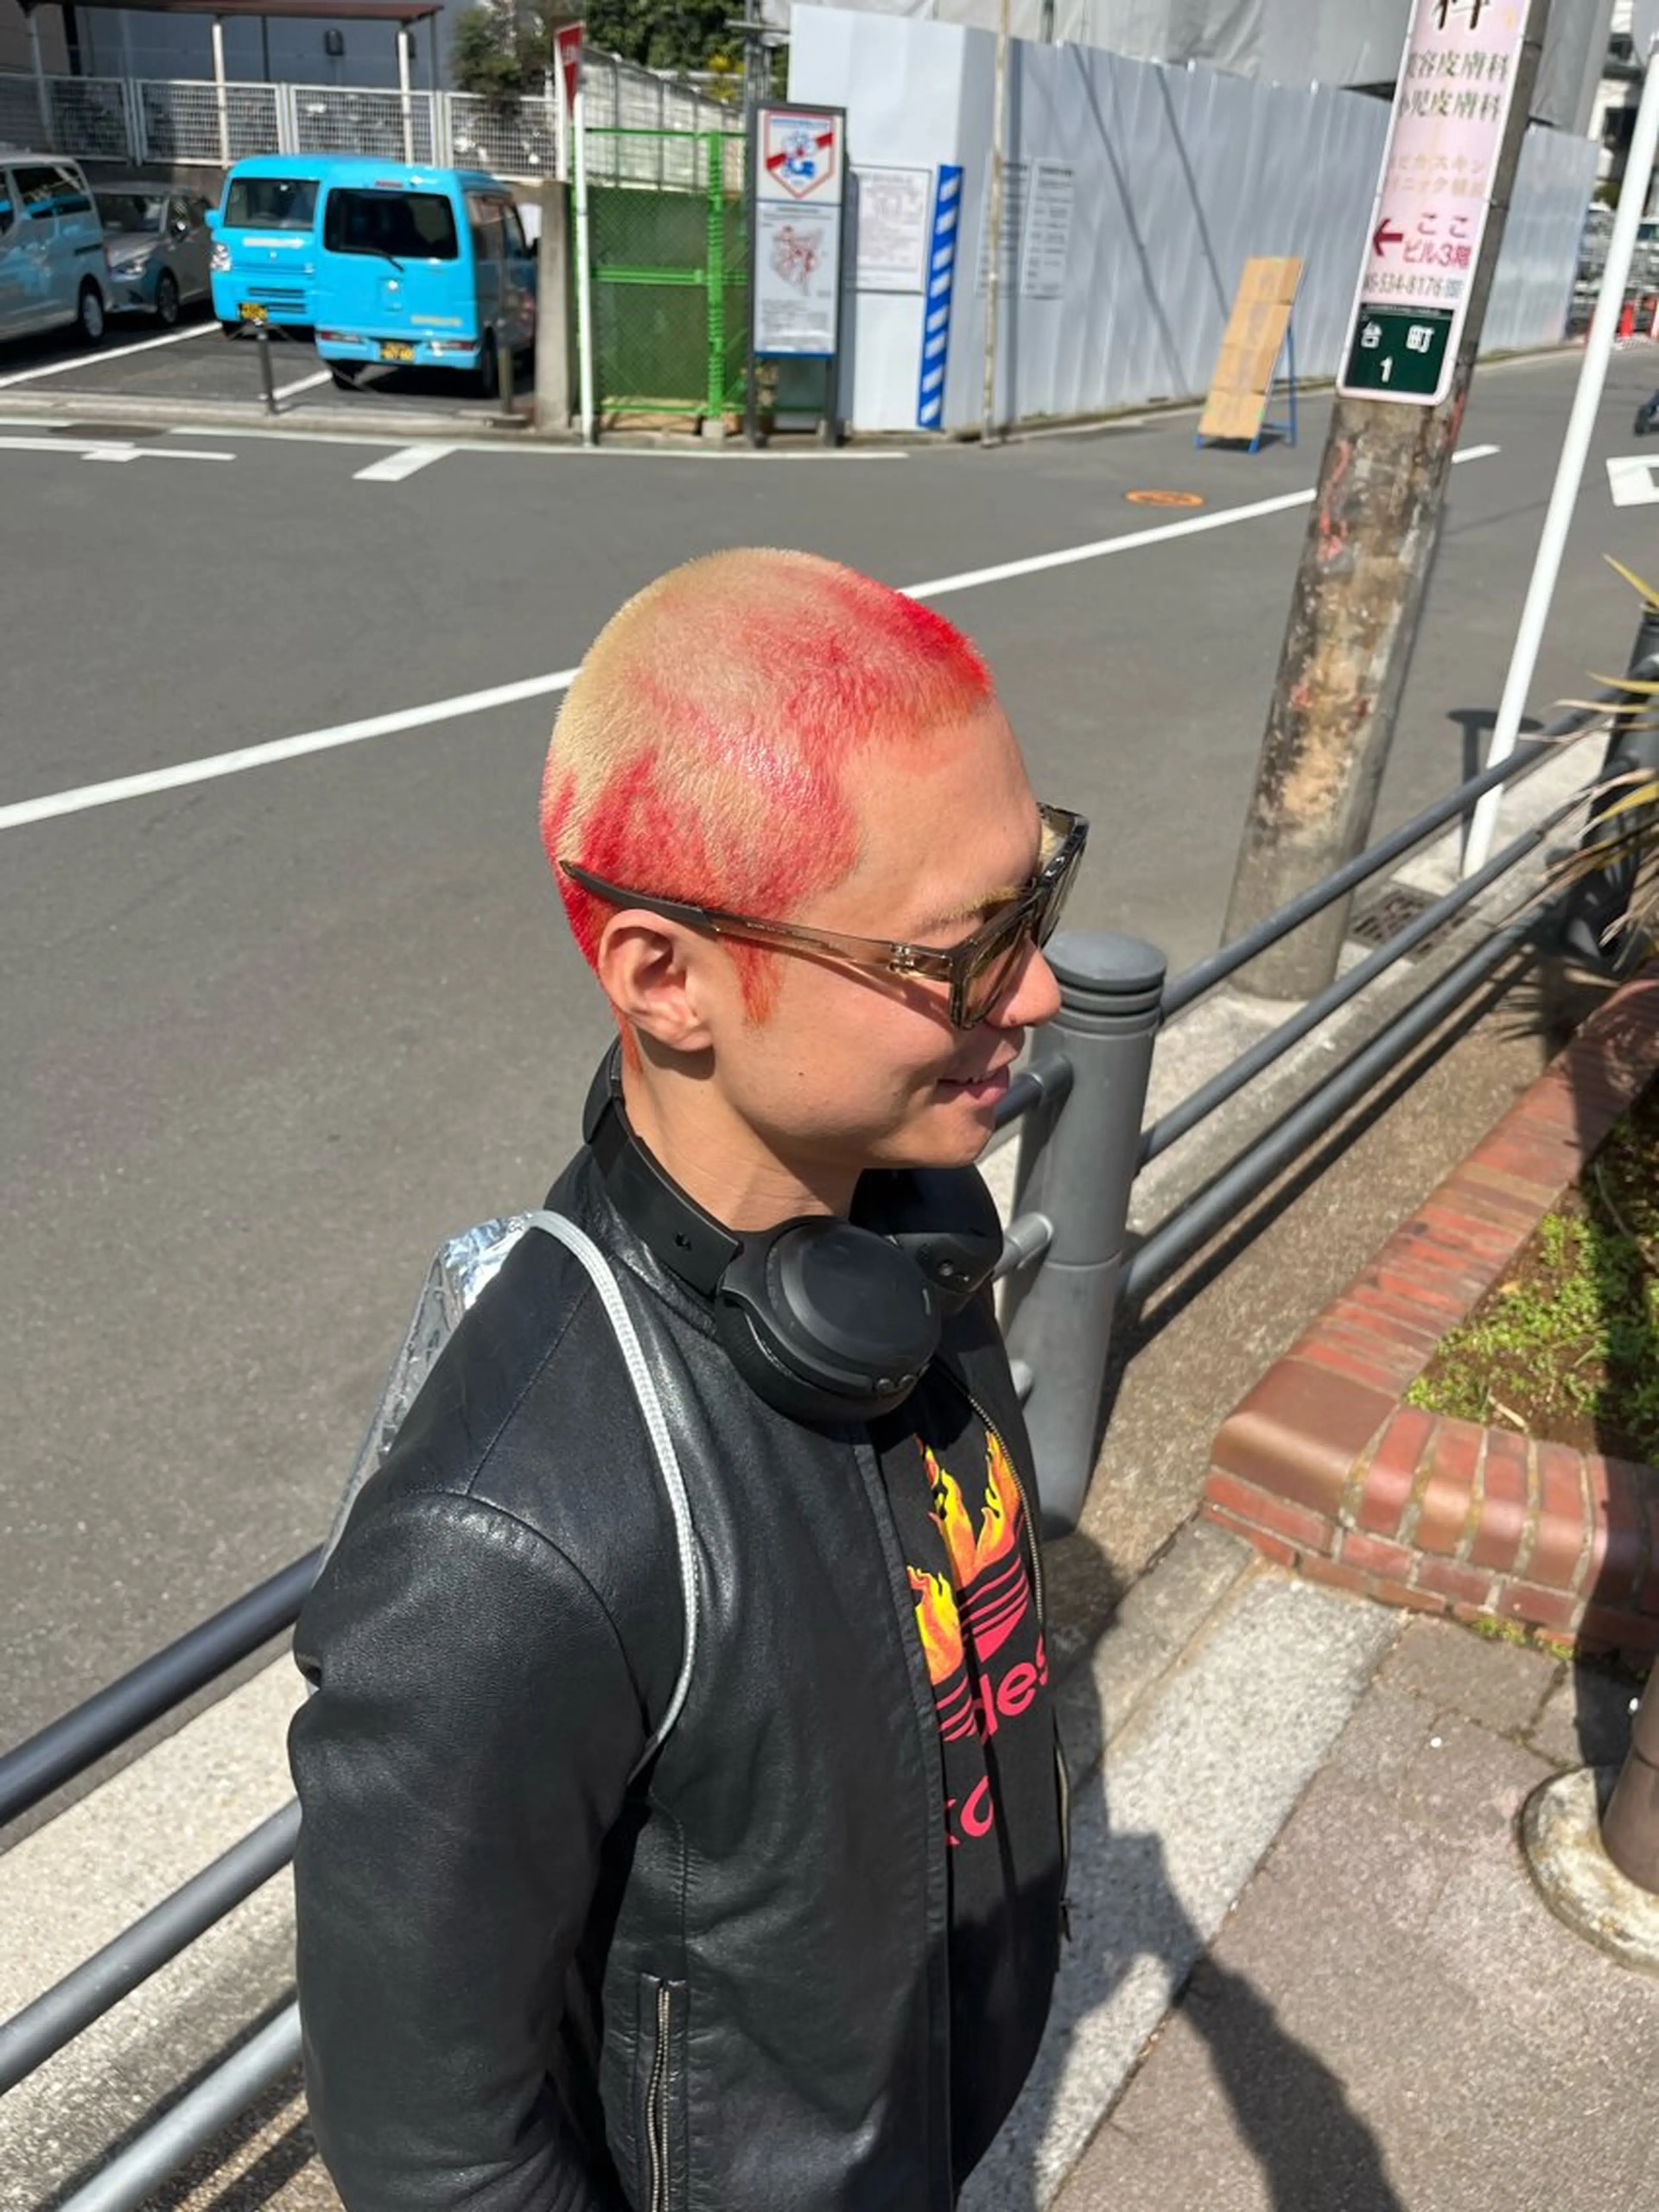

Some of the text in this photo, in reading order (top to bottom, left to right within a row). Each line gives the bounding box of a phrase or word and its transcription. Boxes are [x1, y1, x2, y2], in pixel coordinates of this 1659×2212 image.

[1417, 213, 1468, 238] ここ
[1361, 321, 1434, 353] 台町
[1380, 356, 1392, 383] 1
